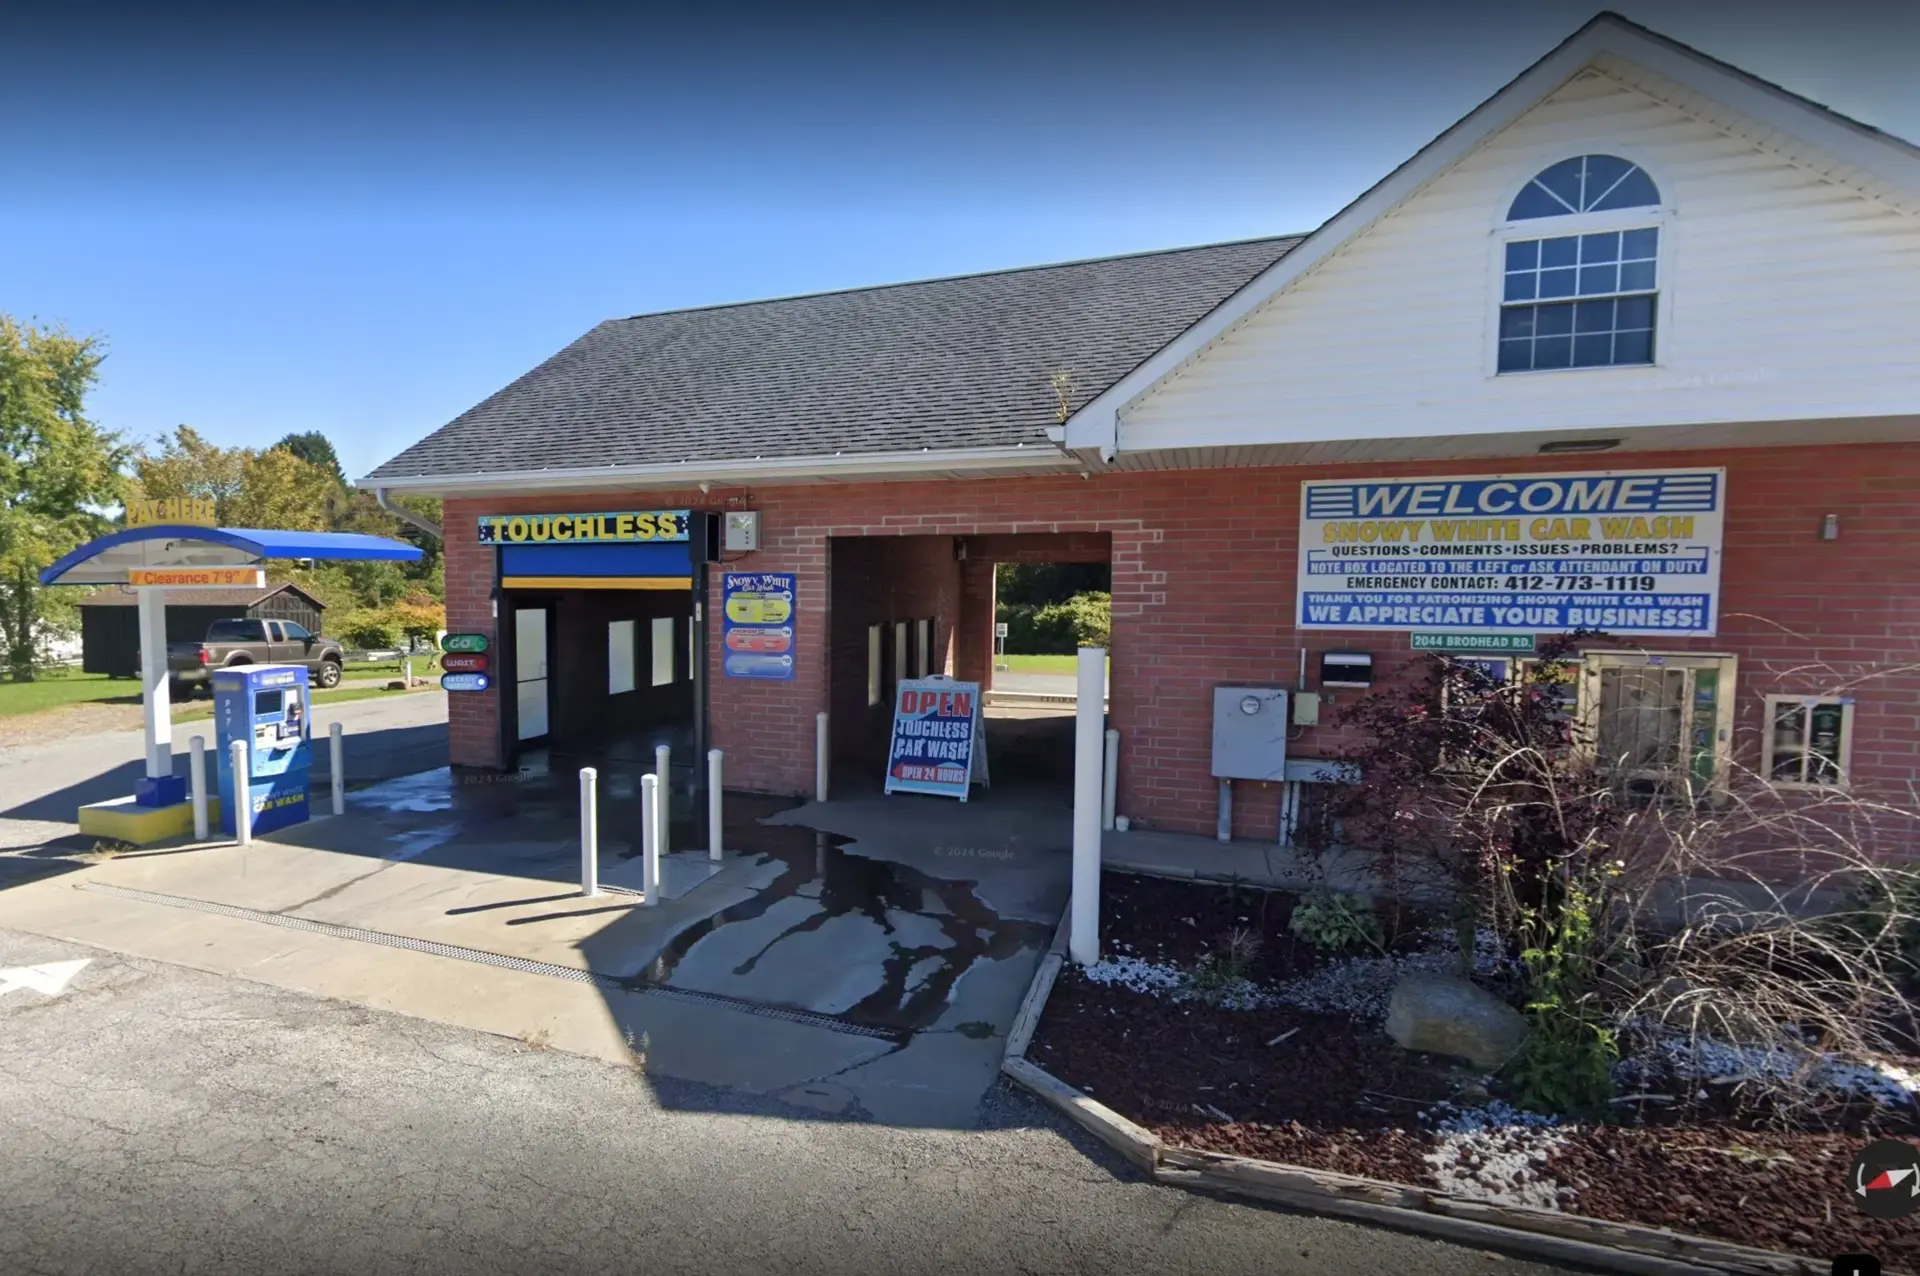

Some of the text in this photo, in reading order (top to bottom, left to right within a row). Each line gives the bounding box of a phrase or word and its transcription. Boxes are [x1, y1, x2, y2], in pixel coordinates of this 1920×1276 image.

[1357, 479, 1659, 515] WELCOME
[488, 512, 679, 542] TOUCHLESS
[1322, 515, 1696, 543] SNOWY WHITE CAR WASH
[1332, 543, 1678, 556] QUESTIONS COMMENTS ISSUES PROBLEMS?
[1310, 560, 1703, 574] NOTE BOX LOCATED TO THE LEFT or ASK ATTENDANT ON DUTY
[144, 571, 209, 585] Clearance
[728, 575, 790, 590] SNOWY WHITE
[1347, 576, 1655, 591] EMERGENCY CONTACT: 412-773-1119
[1308, 595, 1703, 606] THANK YOU FOR PATRONIZING SNOWY WHITE CAR WASH
[1309, 606, 1701, 626] WE APPRECIATE YOUR BUSINESS!
[449, 639, 470, 648] GO
[1415, 636, 1532, 648] 2044 BRODHEAD RD.
[900, 690, 971, 717] OPEN
[897, 719, 970, 739] TOUCHLESS
[894, 738, 970, 760] CAR WASH
[902, 765, 965, 783] OPEN 24 HOURS
